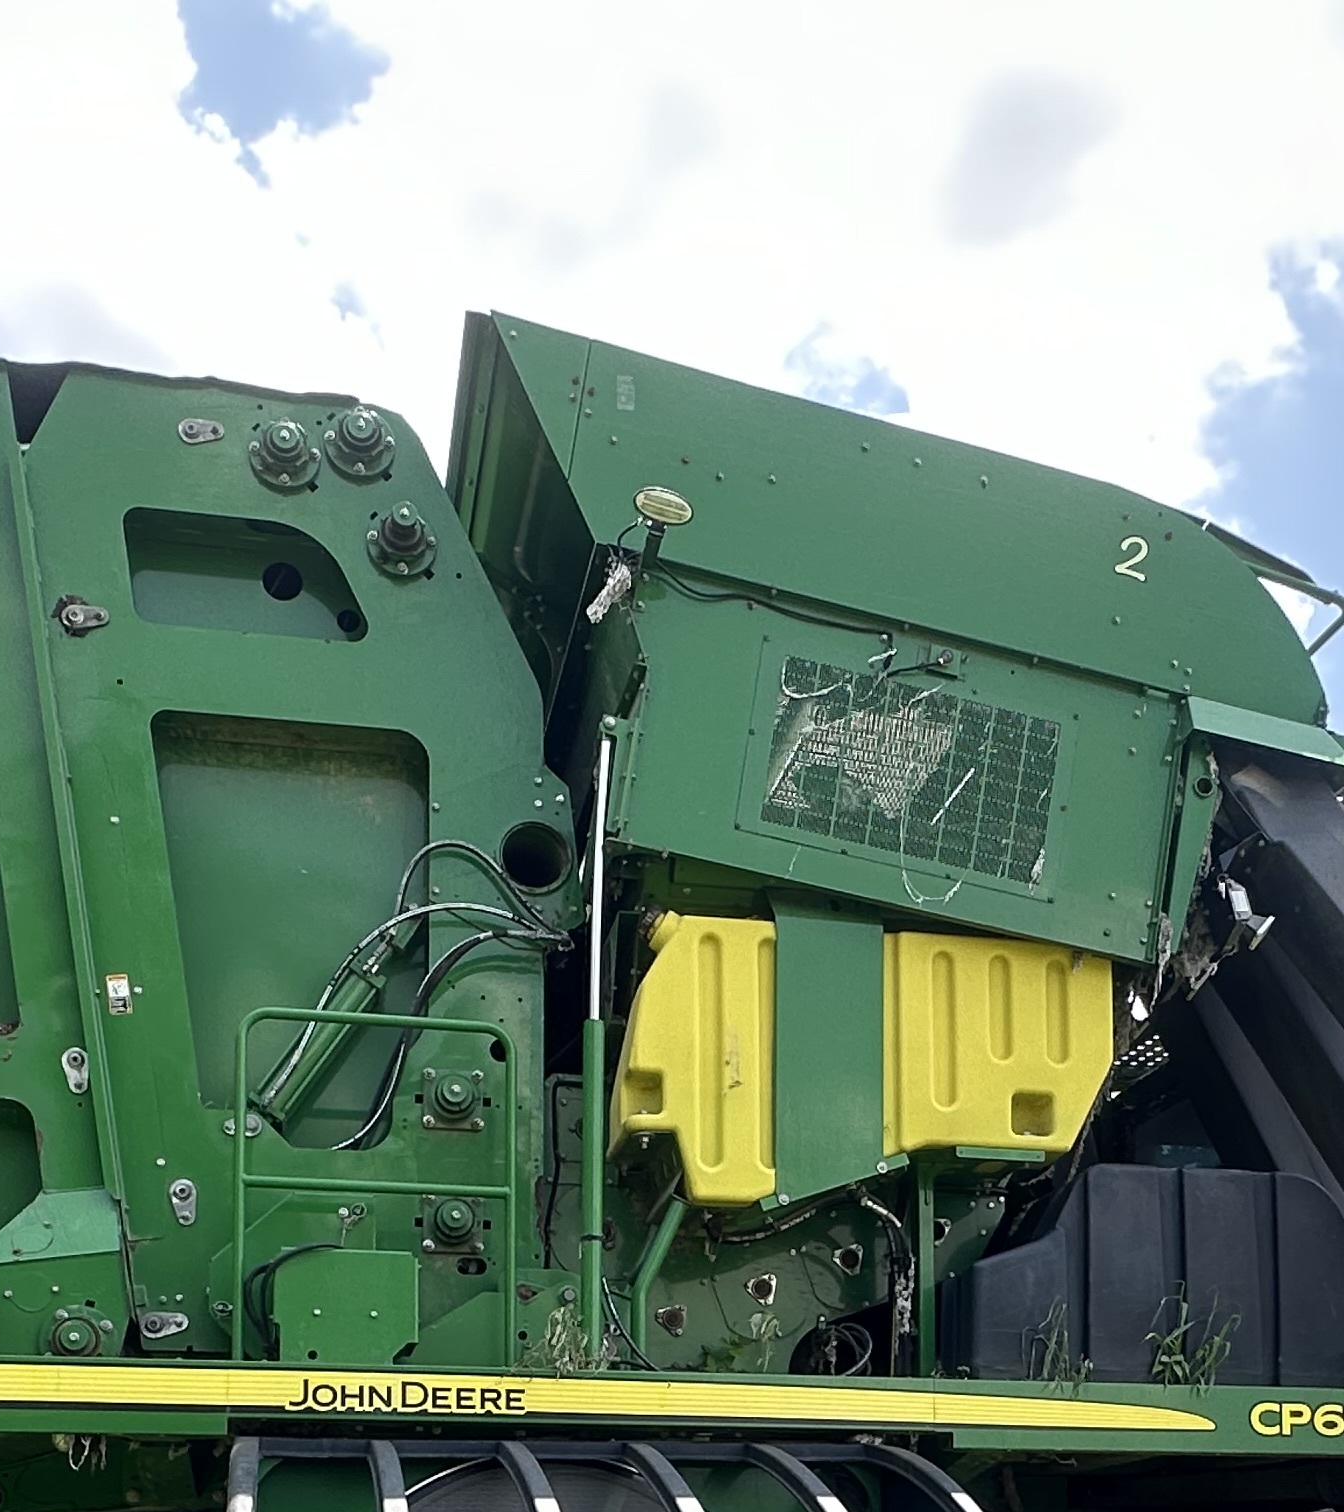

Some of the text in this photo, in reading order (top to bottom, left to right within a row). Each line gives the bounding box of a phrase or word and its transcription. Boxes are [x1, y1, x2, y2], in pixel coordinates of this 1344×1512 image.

[1115, 536, 1149, 582] 2
[288, 1378, 526, 1411] JOHN DEERE
